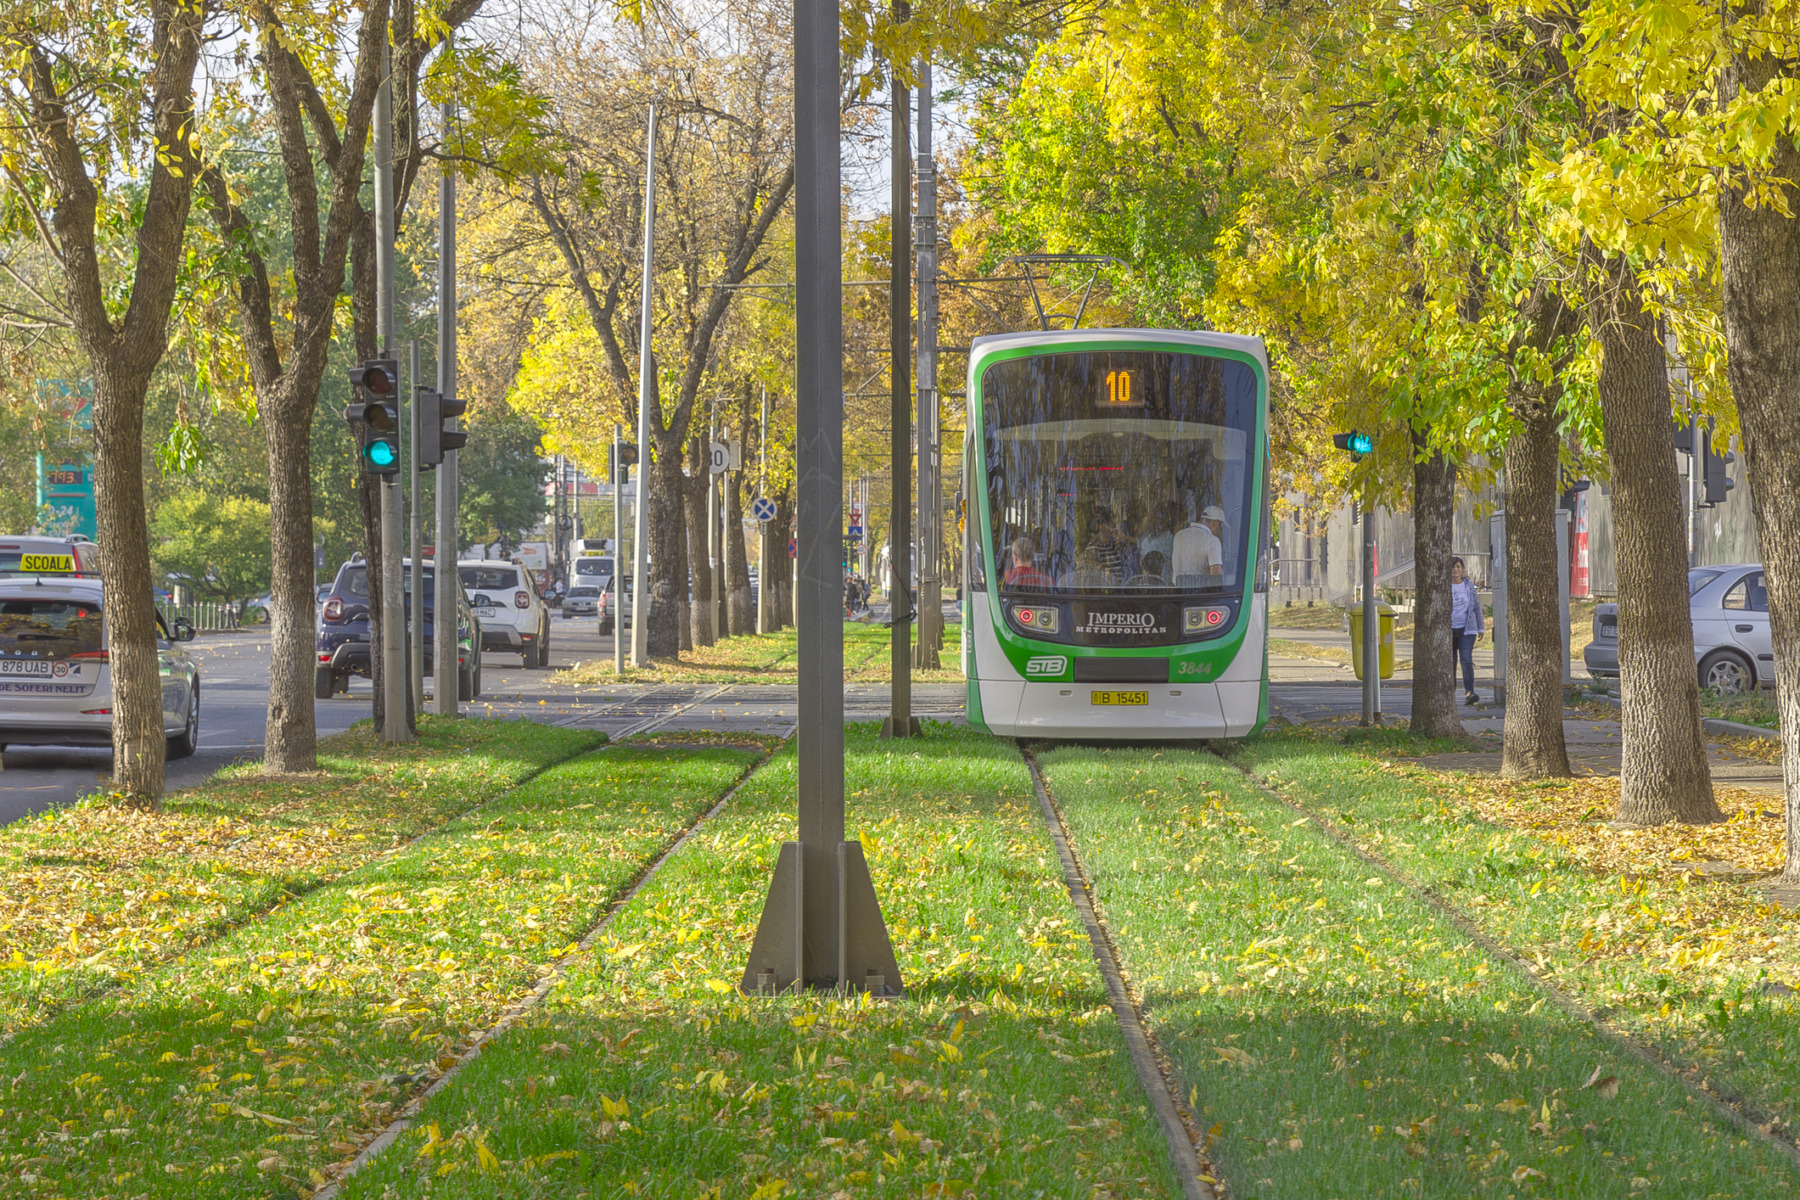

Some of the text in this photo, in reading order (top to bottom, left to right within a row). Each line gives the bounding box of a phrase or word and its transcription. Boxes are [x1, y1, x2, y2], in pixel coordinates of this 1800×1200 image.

[1105, 371, 1130, 402] 10
[25, 555, 71, 571] SCOALA
[1087, 612, 1155, 627] IMPERIO
[1075, 626, 1167, 634] METROPOLITAN
[2, 661, 49, 673] 878 UAB
[1026, 659, 1063, 672] STB
[1178, 661, 1212, 675] 3844
[15, 684, 52, 692] SOFERI
[1102, 692, 1146, 704] B 15451
